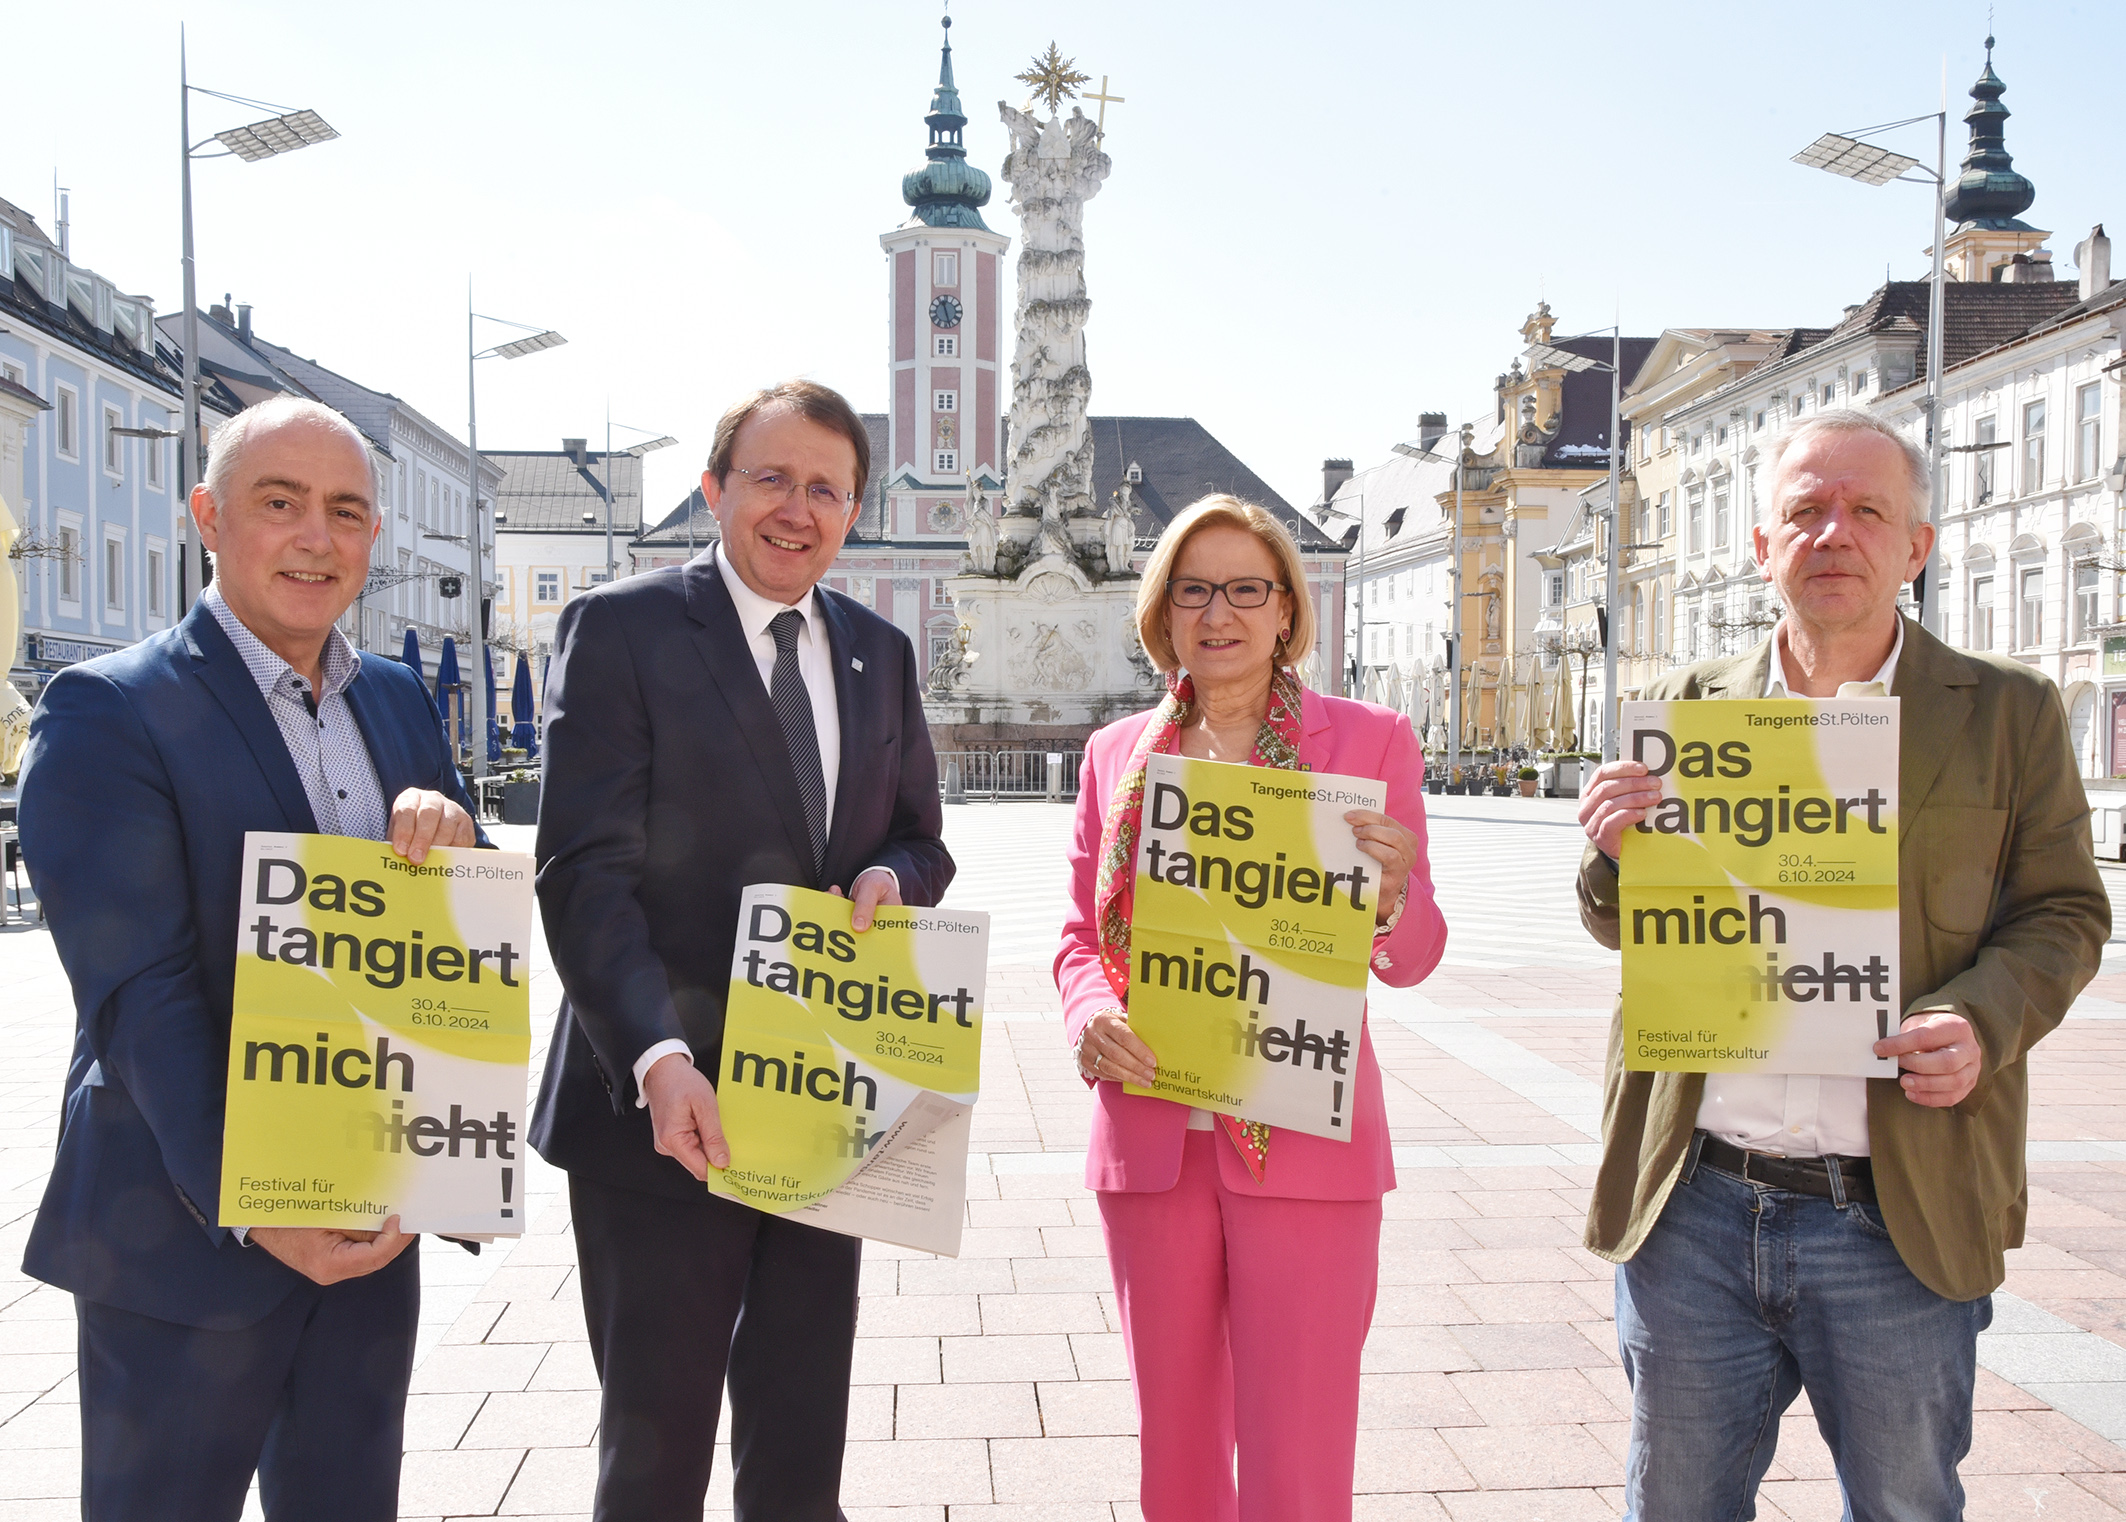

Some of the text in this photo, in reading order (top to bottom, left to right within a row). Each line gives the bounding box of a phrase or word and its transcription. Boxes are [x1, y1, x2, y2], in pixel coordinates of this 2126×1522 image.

[45, 641, 111, 661] RESTAURANT RHO
[1745, 713, 1888, 729] TangenteSt.Pölten
[1633, 730, 1751, 778] Das
[1151, 782, 1254, 841] Das
[1251, 782, 1376, 806] TangenteSt.Pölten
[380, 855, 524, 882] TangenteSt.Pölten
[1146, 839, 1369, 911] tangiert
[1779, 870, 1855, 882] 6.10. 2024
[255, 858, 386, 917] Das
[748, 904, 857, 963] Das
[873, 919, 979, 934] ngenteSt.Pölten
[1633, 895, 1786, 944] mich
[251, 916, 519, 989] tangiert
[1268, 934, 1334, 956] 6.10. 2024
[743, 946, 973, 1028] tangiert
[1141, 947, 1269, 1005] mich
[1726, 952, 1889, 1002] nicht
[411, 1013, 490, 1030] 6.10. 2024
[1638, 1030, 1717, 1042] Festival für
[875, 1044, 944, 1065] 6.10. 2024
[1213, 1010, 1350, 1075] nicht
[1638, 1045, 1768, 1061] Gegenwartskultur
[244, 1033, 413, 1092] mich
[732, 1047, 879, 1111] mich
[1155, 1067, 1201, 1084] tival für
[1153, 1079, 1243, 1106] genwartskultur
[1331, 1081, 1343, 1127] !
[347, 1099, 516, 1160] nicht
[239, 1176, 335, 1195] Festival für
[501, 1168, 513, 1218] !
[781, 1176, 801, 1188] für
[238, 1196, 389, 1216] Gegenwartskultur
